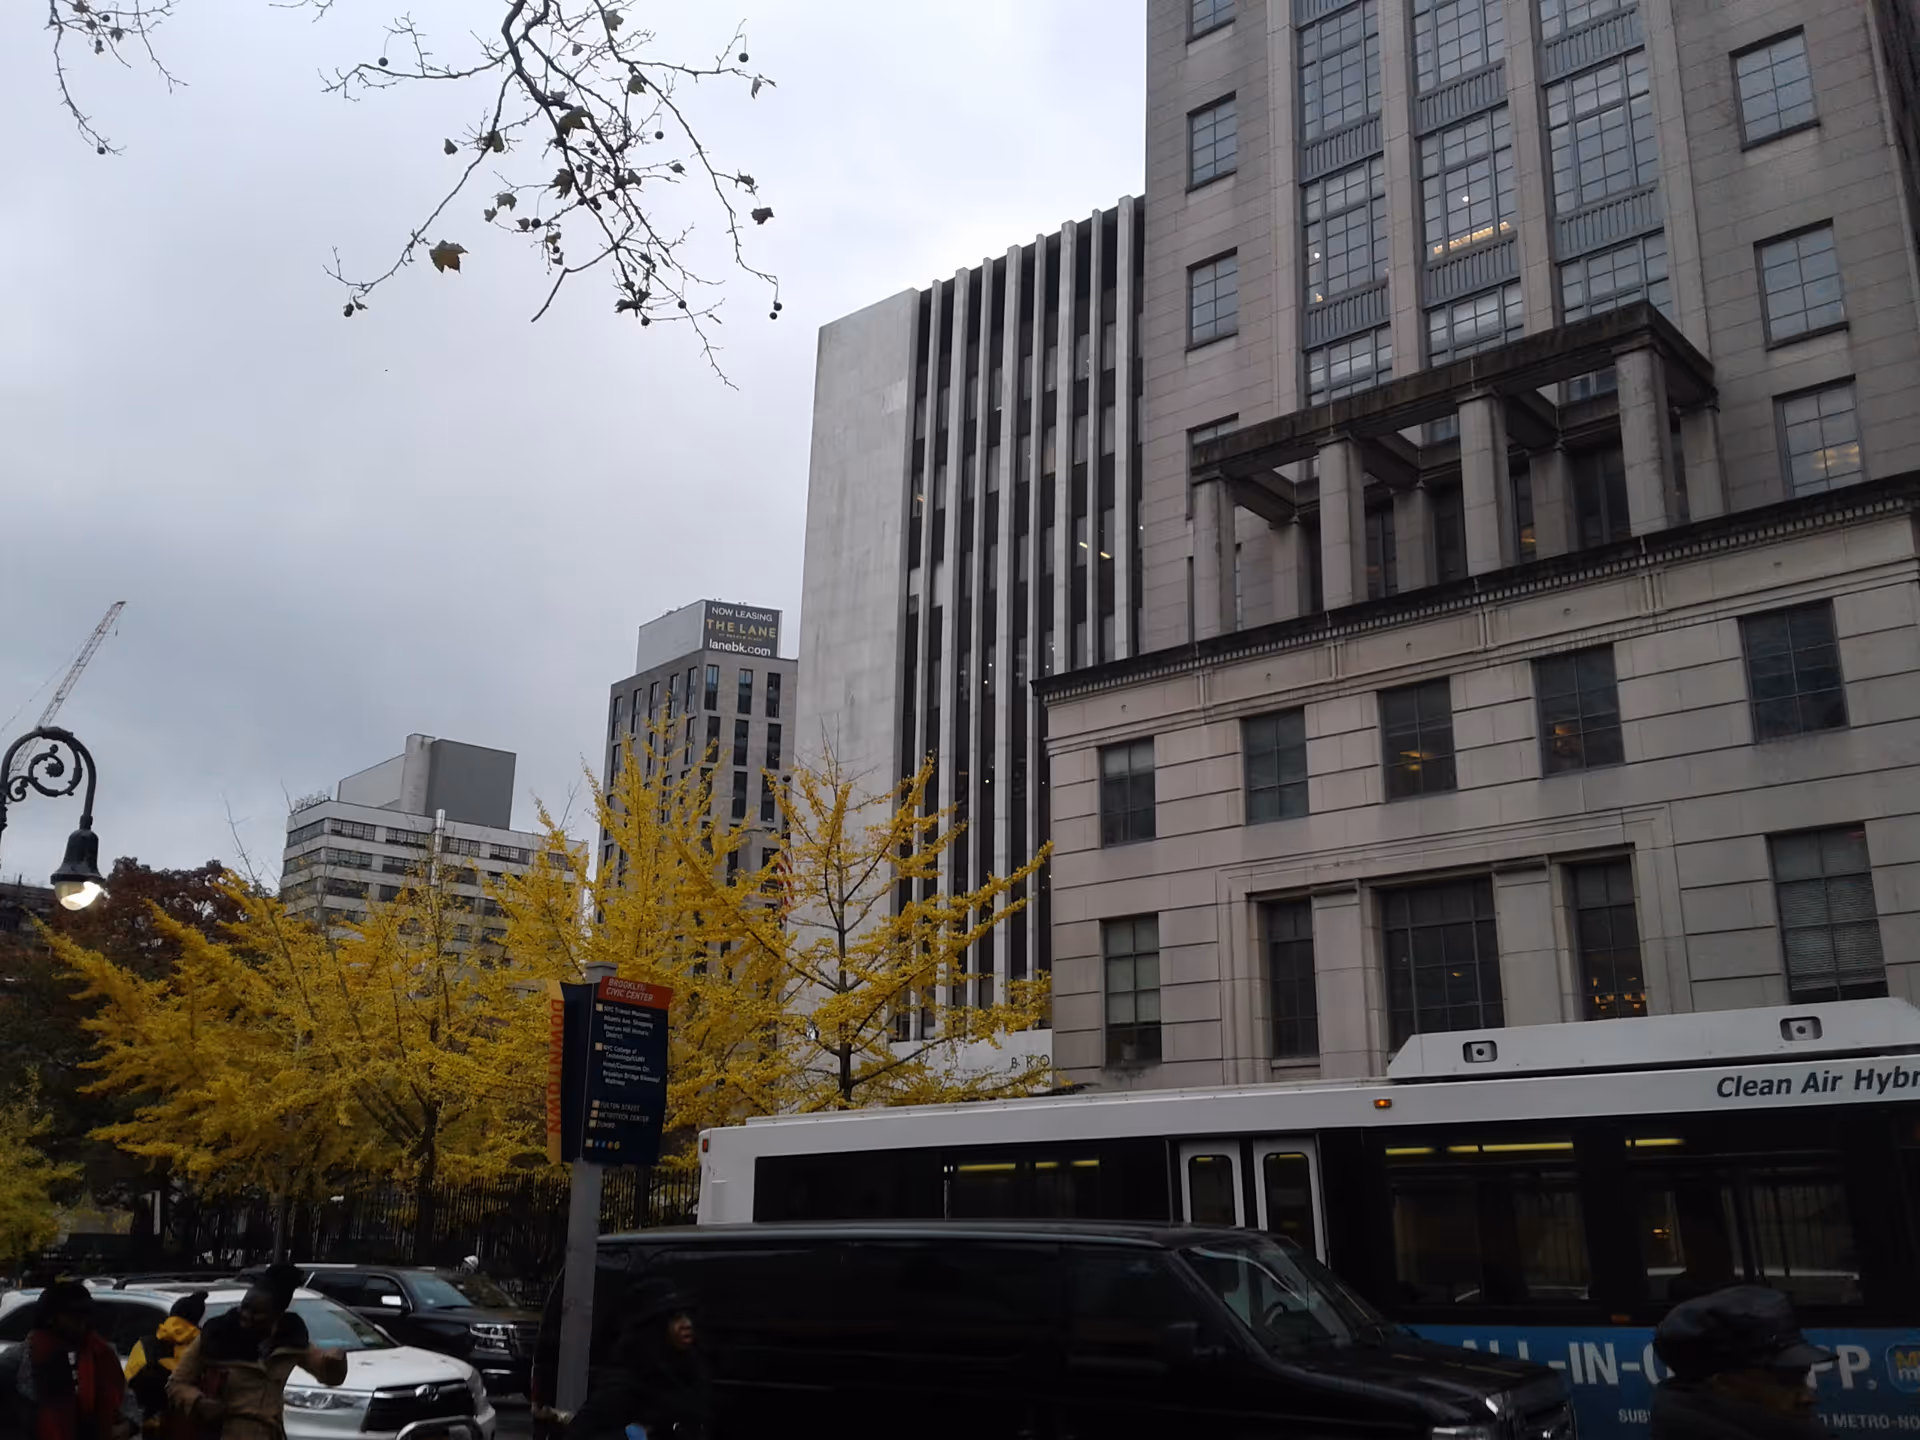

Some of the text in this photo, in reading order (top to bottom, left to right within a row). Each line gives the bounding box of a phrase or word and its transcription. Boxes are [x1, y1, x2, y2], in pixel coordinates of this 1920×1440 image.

[711, 606, 773, 622] NOW LEASING
[706, 618, 736, 633] THE
[739, 623, 777, 638] LANE
[709, 638, 771, 657] lanebk.com
[606, 987, 654, 1002] CIVIC CENTER
[547, 999, 565, 1134] DOWNTOWN
[1716, 1065, 1920, 1098] Clean Air Hybr
[1617, 1407, 1651, 1424] SUB
